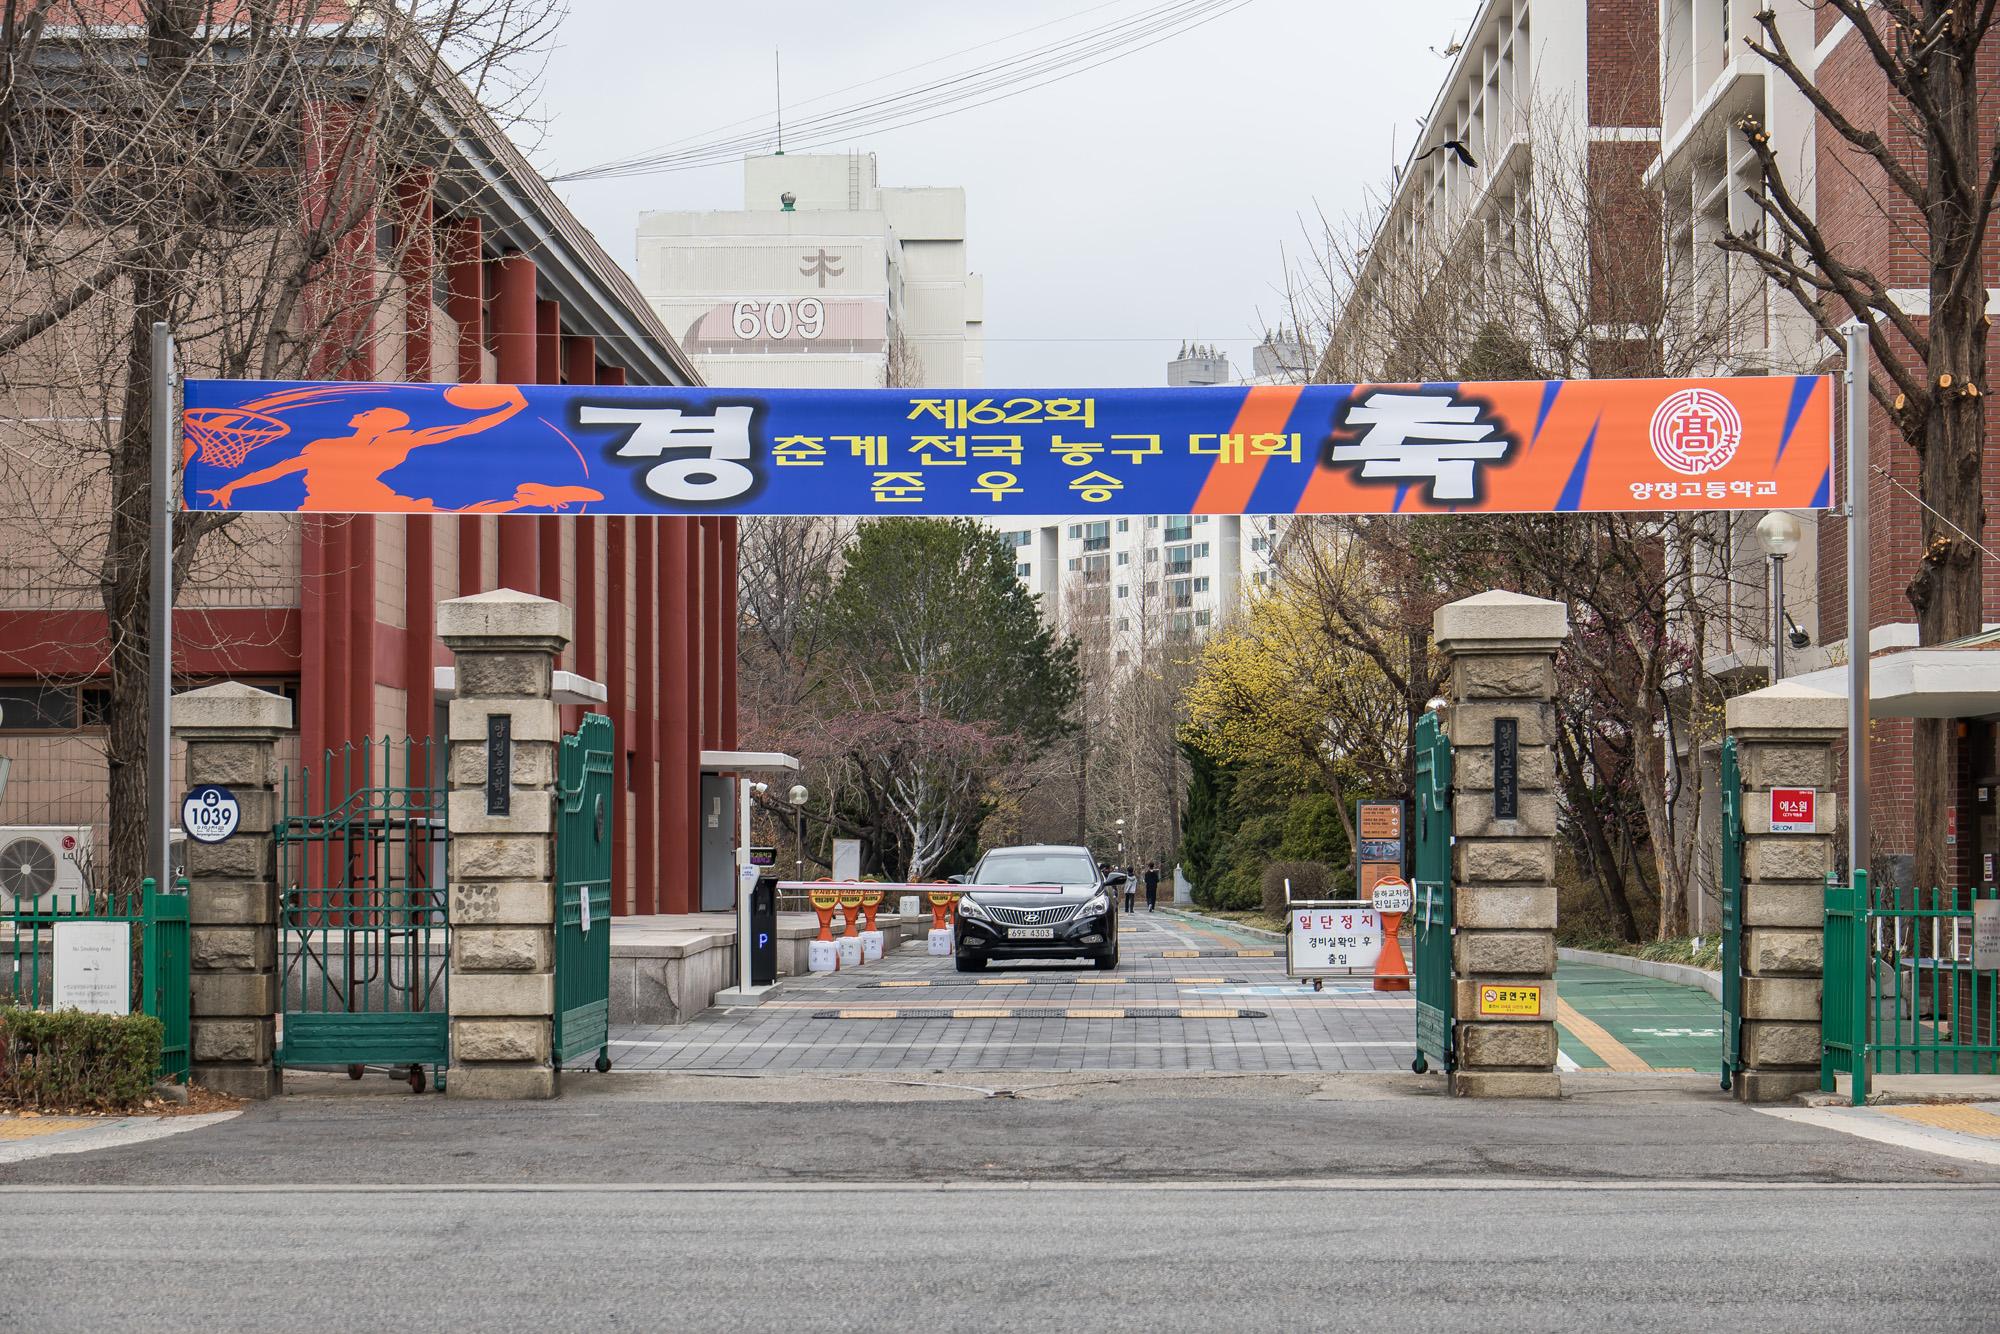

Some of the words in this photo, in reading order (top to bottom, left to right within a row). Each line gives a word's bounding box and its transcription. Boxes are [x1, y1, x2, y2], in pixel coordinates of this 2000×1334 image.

[732, 298, 825, 340] 609
[907, 398, 1095, 429] 제62회
[580, 406, 754, 500] 경
[772, 435, 888, 466] 춘계
[908, 434, 1024, 466] 전국
[1050, 434, 1163, 466] 농구
[1189, 433, 1302, 464] 대회
[1332, 393, 1509, 499] 축
[1629, 480, 1778, 501] 양정고등학교
[492, 721, 506, 810] 양정중학교
[1500, 723, 1513, 814] 양정고등학교
[1779, 801, 1808, 812] 에스원
[192, 808, 232, 826] 1039
[1374, 889, 1410, 898] 등하교차량
[1374, 898, 1410, 909] 진입금지
[80, 945, 100, 953] Smoking
[759, 933, 769, 949] P
[1308, 936, 1357, 948] 경비실확인
[1362, 936, 1372, 947] 후
[1327, 953, 1348, 965] 출입
